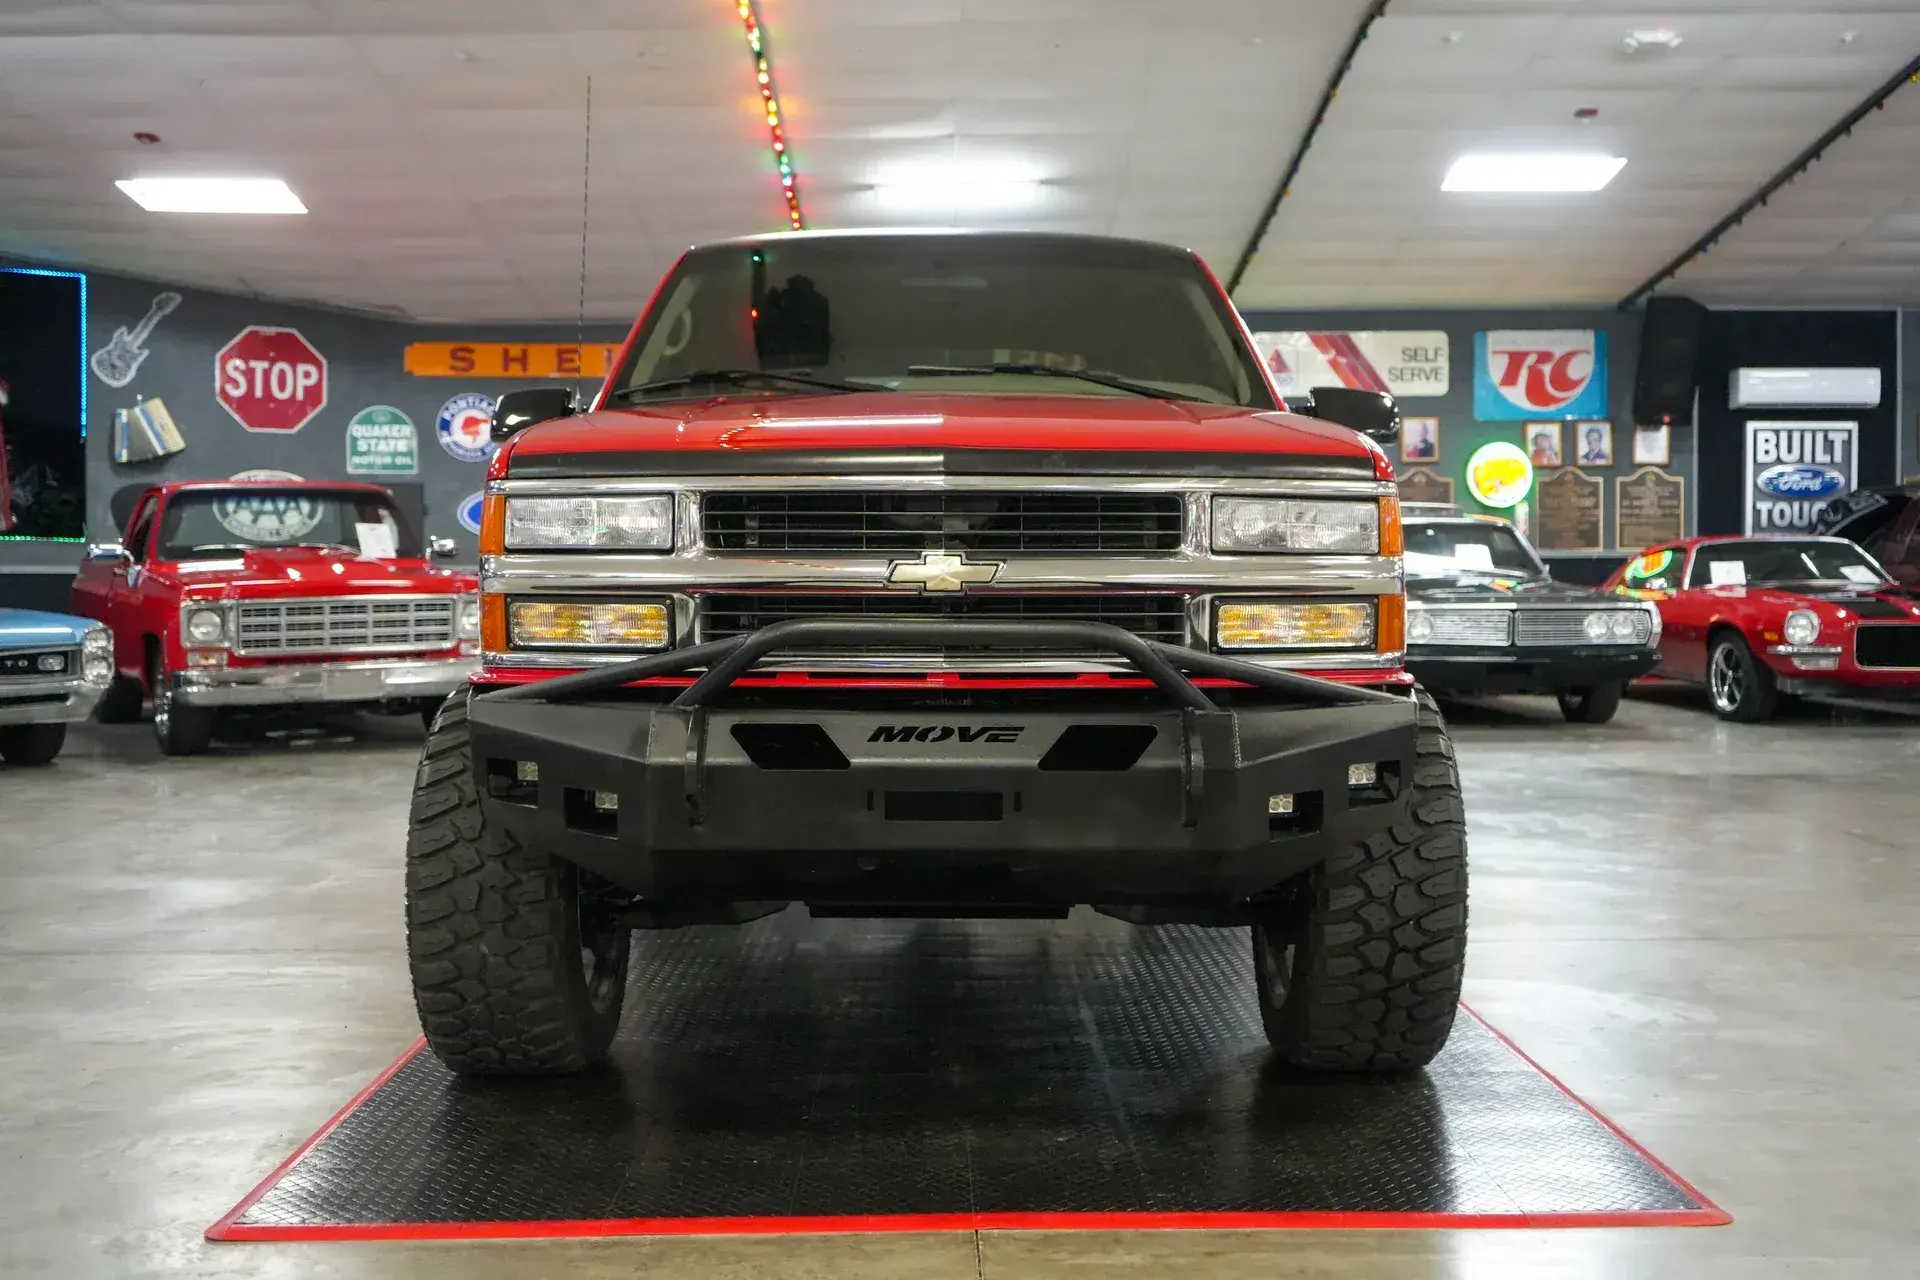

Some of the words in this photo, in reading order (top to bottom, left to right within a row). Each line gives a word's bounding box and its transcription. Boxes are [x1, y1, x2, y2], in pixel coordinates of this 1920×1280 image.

[1401, 346, 1443, 364] SELF
[224, 357, 319, 401] STOP
[1388, 366, 1443, 383] SERVE
[1492, 349, 1592, 407] RC
[351, 423, 412, 440] QUAKER
[357, 438, 408, 453] STATE
[1756, 430, 1849, 464] BUILT
[1779, 472, 1823, 492] Ford
[866, 725, 1026, 743] MOVE
